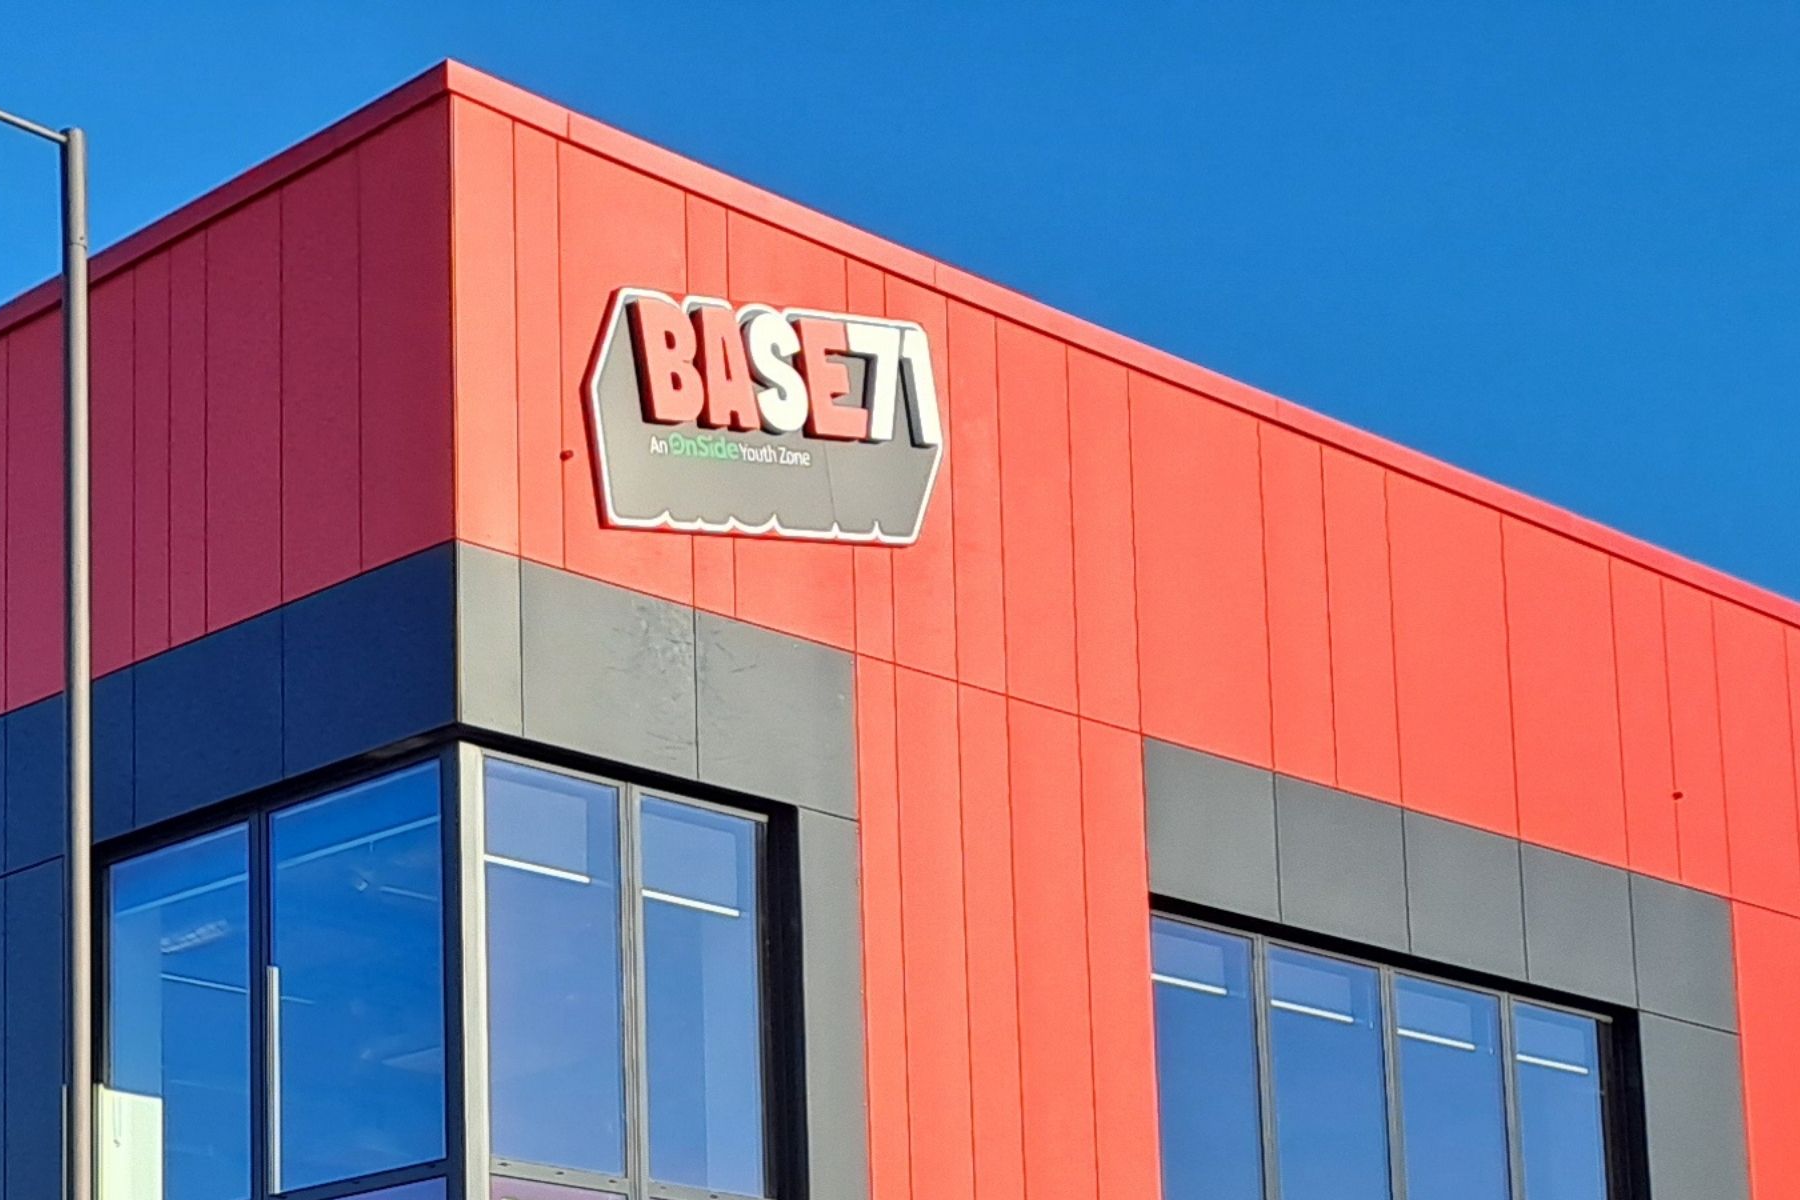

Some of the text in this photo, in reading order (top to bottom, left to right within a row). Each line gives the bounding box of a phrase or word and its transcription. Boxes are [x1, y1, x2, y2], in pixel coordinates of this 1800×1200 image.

[626, 298, 942, 448] BASE71
[650, 432, 811, 466] An OnSide Youth Zone
